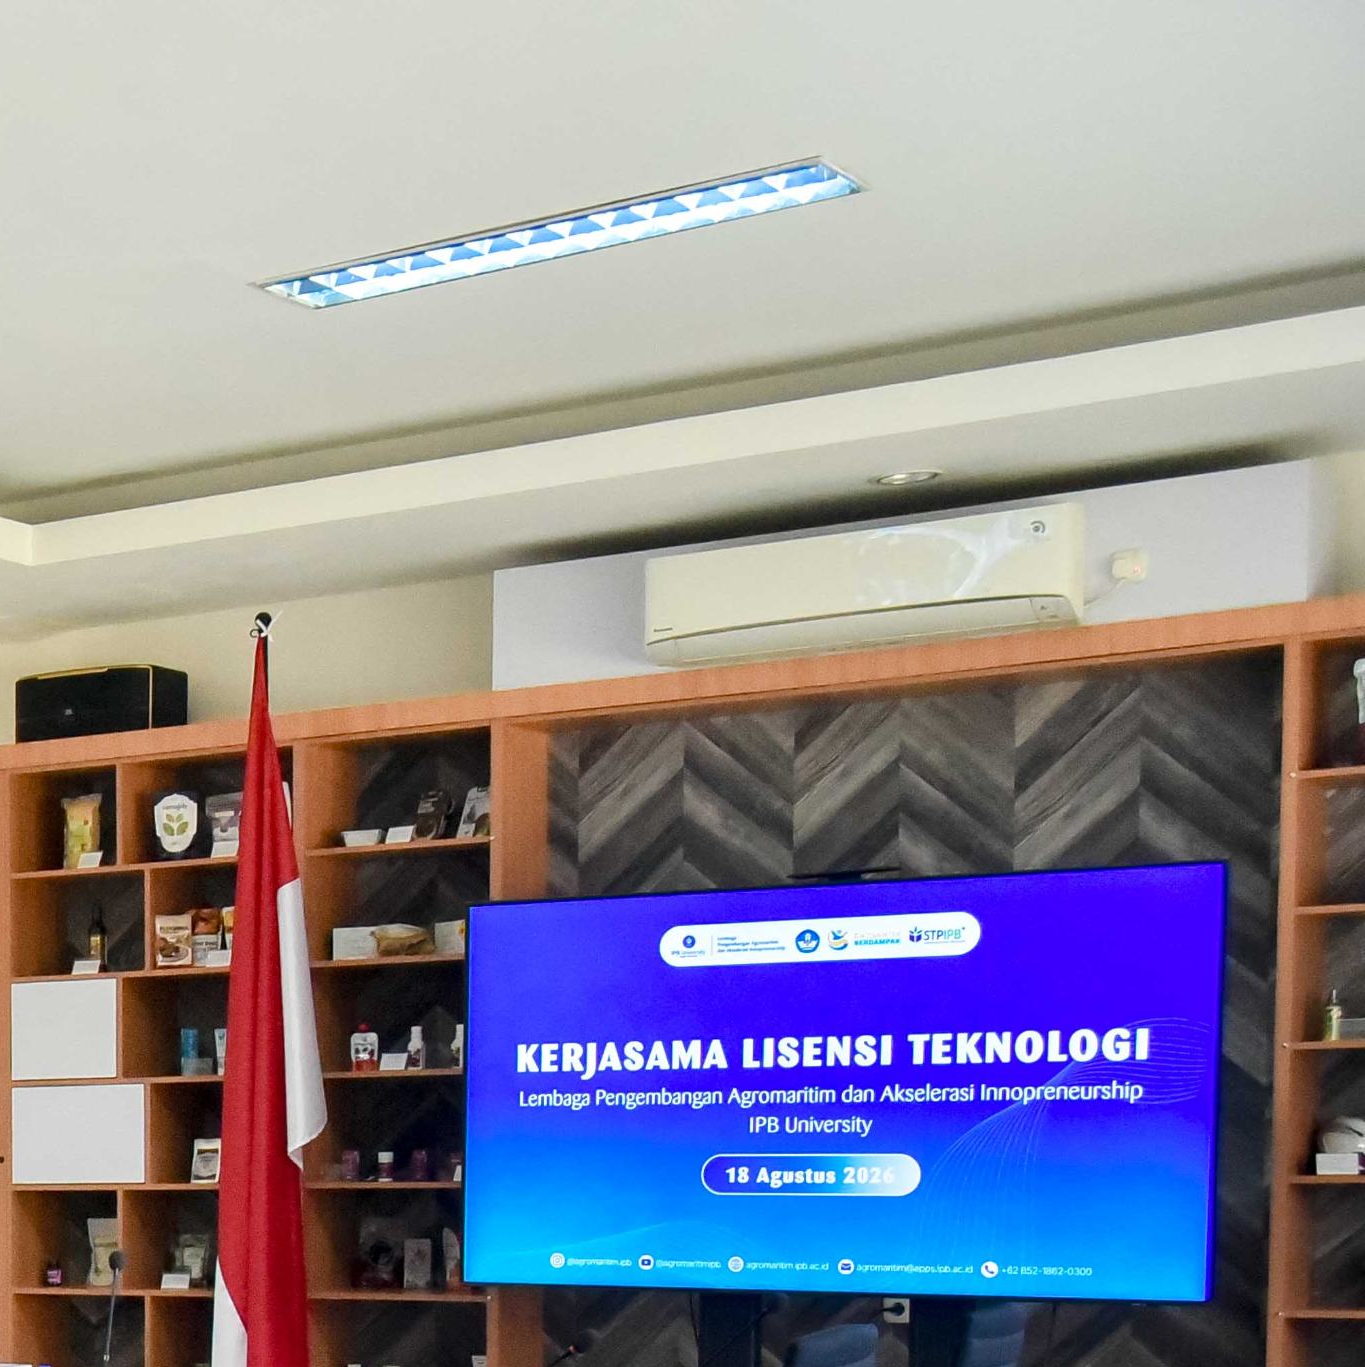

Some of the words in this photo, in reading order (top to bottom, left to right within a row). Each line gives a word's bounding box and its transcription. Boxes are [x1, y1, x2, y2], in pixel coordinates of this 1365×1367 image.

[516, 1039, 729, 1080] KERJASAMA
[742, 1034, 893, 1069] LISENSI
[907, 1027, 1150, 1065] TEKNOLOGI
[519, 1088, 591, 1110] Lembaga
[595, 1087, 723, 1110] Pengembangan
[728, 1085, 836, 1108] Agromaritim
[841, 1084, 875, 1103] dan
[880, 1083, 975, 1103] Akselerasi
[980, 1080, 1144, 1104] Innopreneurship
[749, 1116, 779, 1134] IPB
[785, 1115, 873, 1137] University
[725, 1166, 750, 1184] 18
[756, 1166, 837, 1188] Agustus
[842, 1166, 896, 1184] 2026
